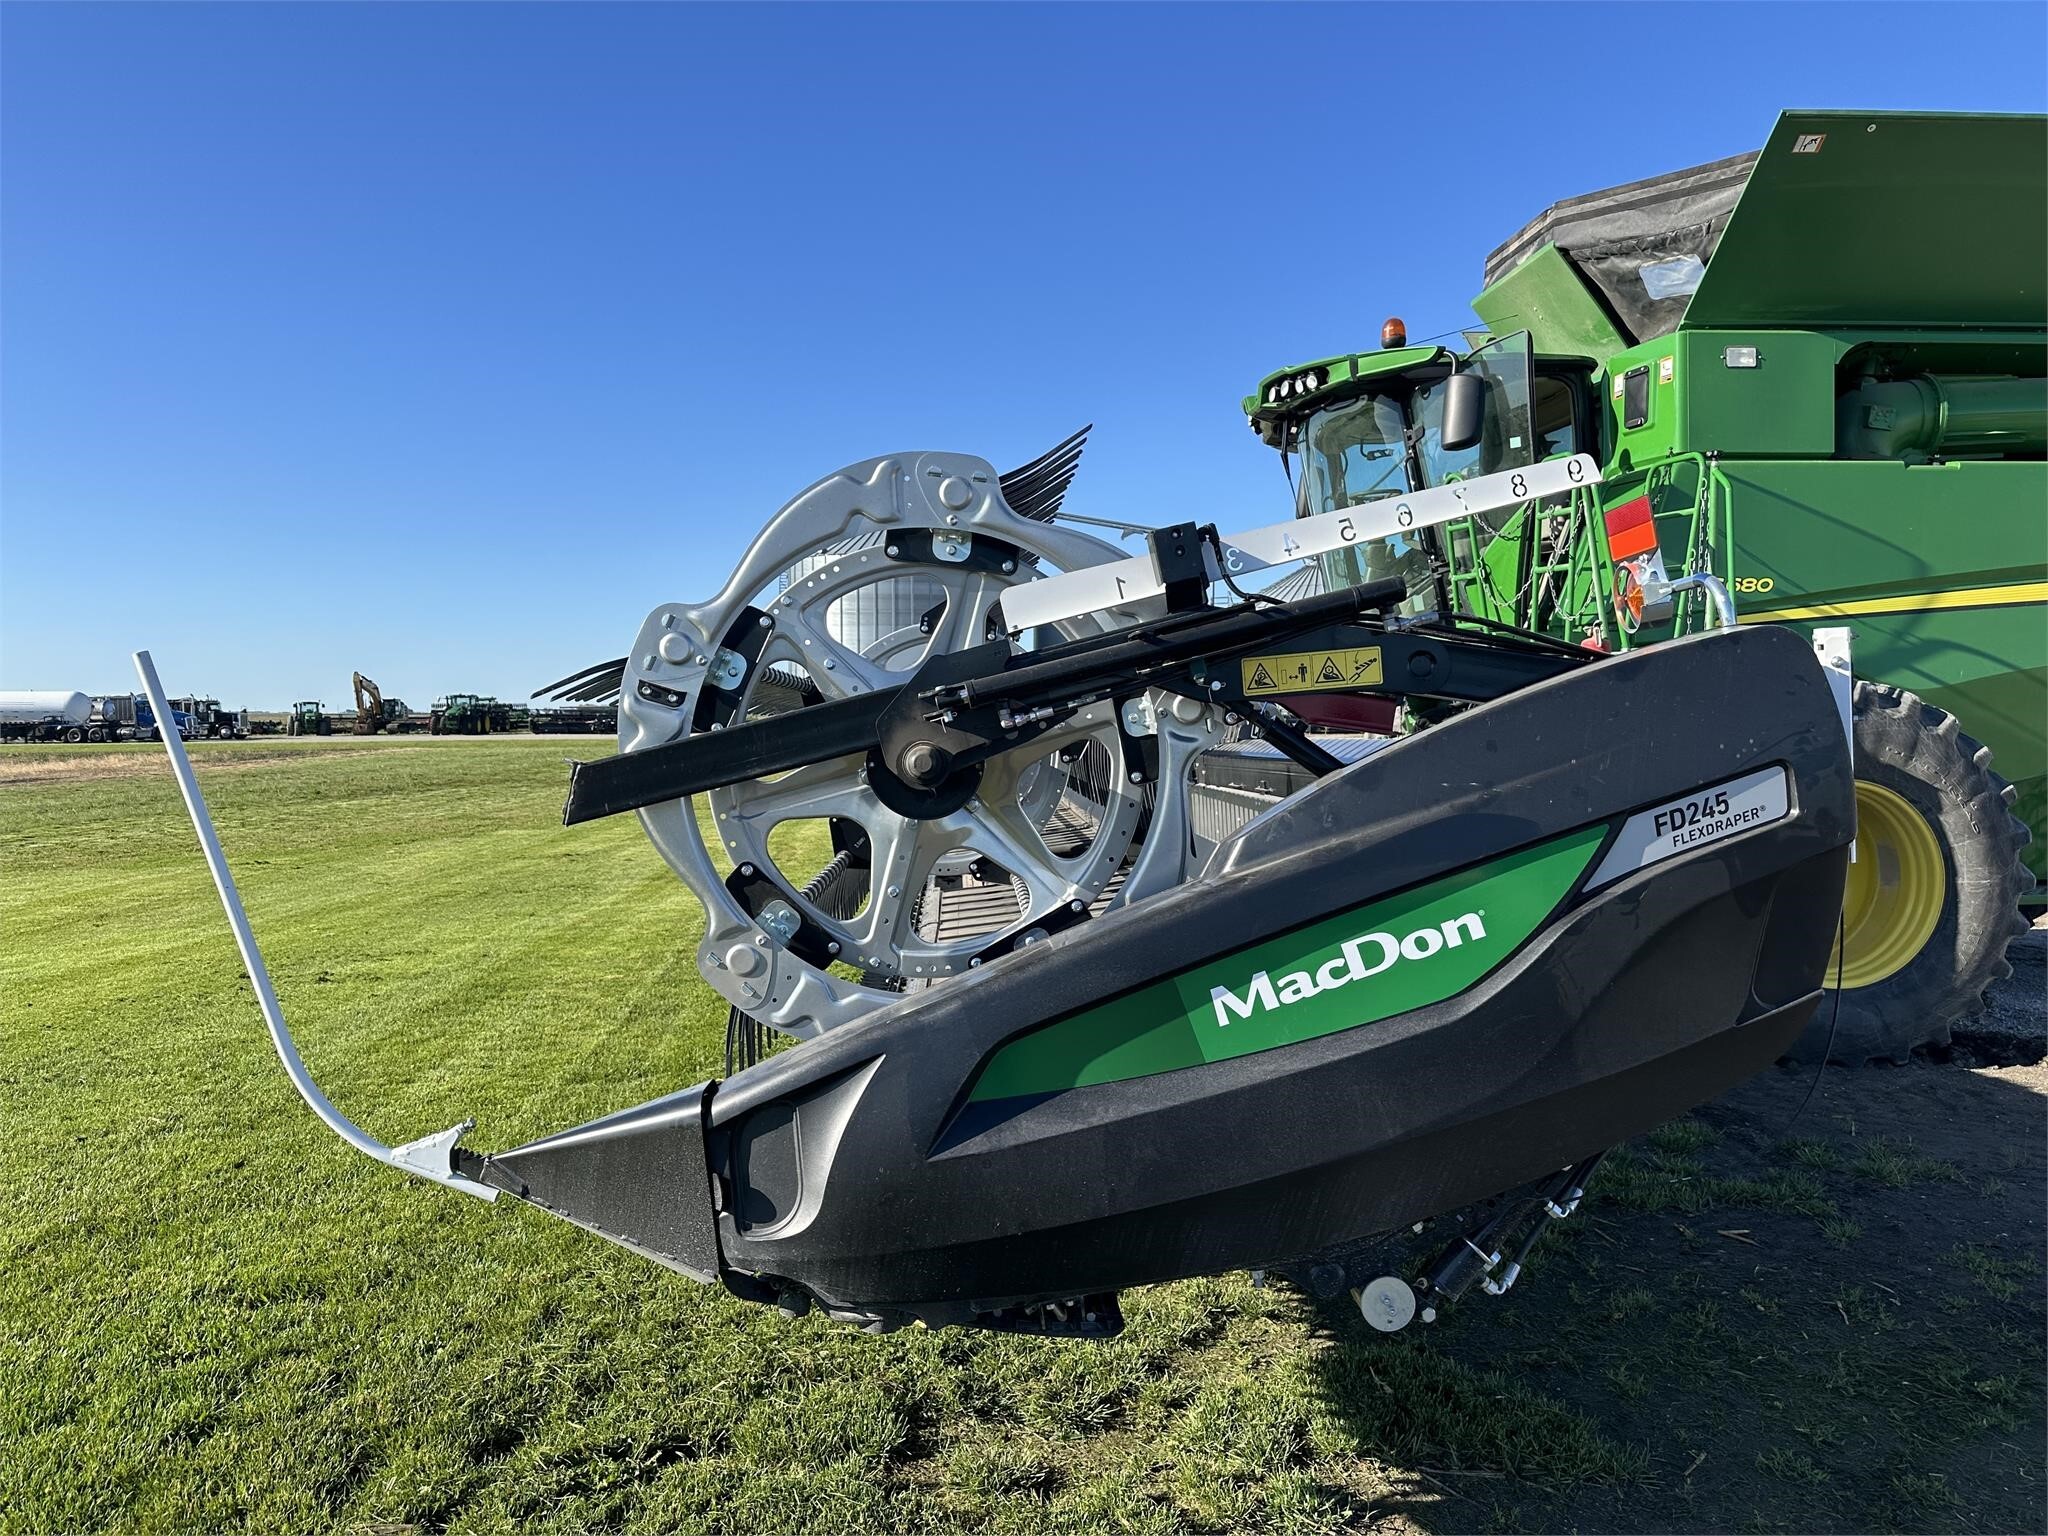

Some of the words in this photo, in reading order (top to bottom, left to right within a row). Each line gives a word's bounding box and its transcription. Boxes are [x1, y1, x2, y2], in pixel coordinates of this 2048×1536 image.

[1717, 577, 1774, 593] 680
[1654, 791, 1729, 837] FD245
[1210, 912, 1486, 1027] MacDon
